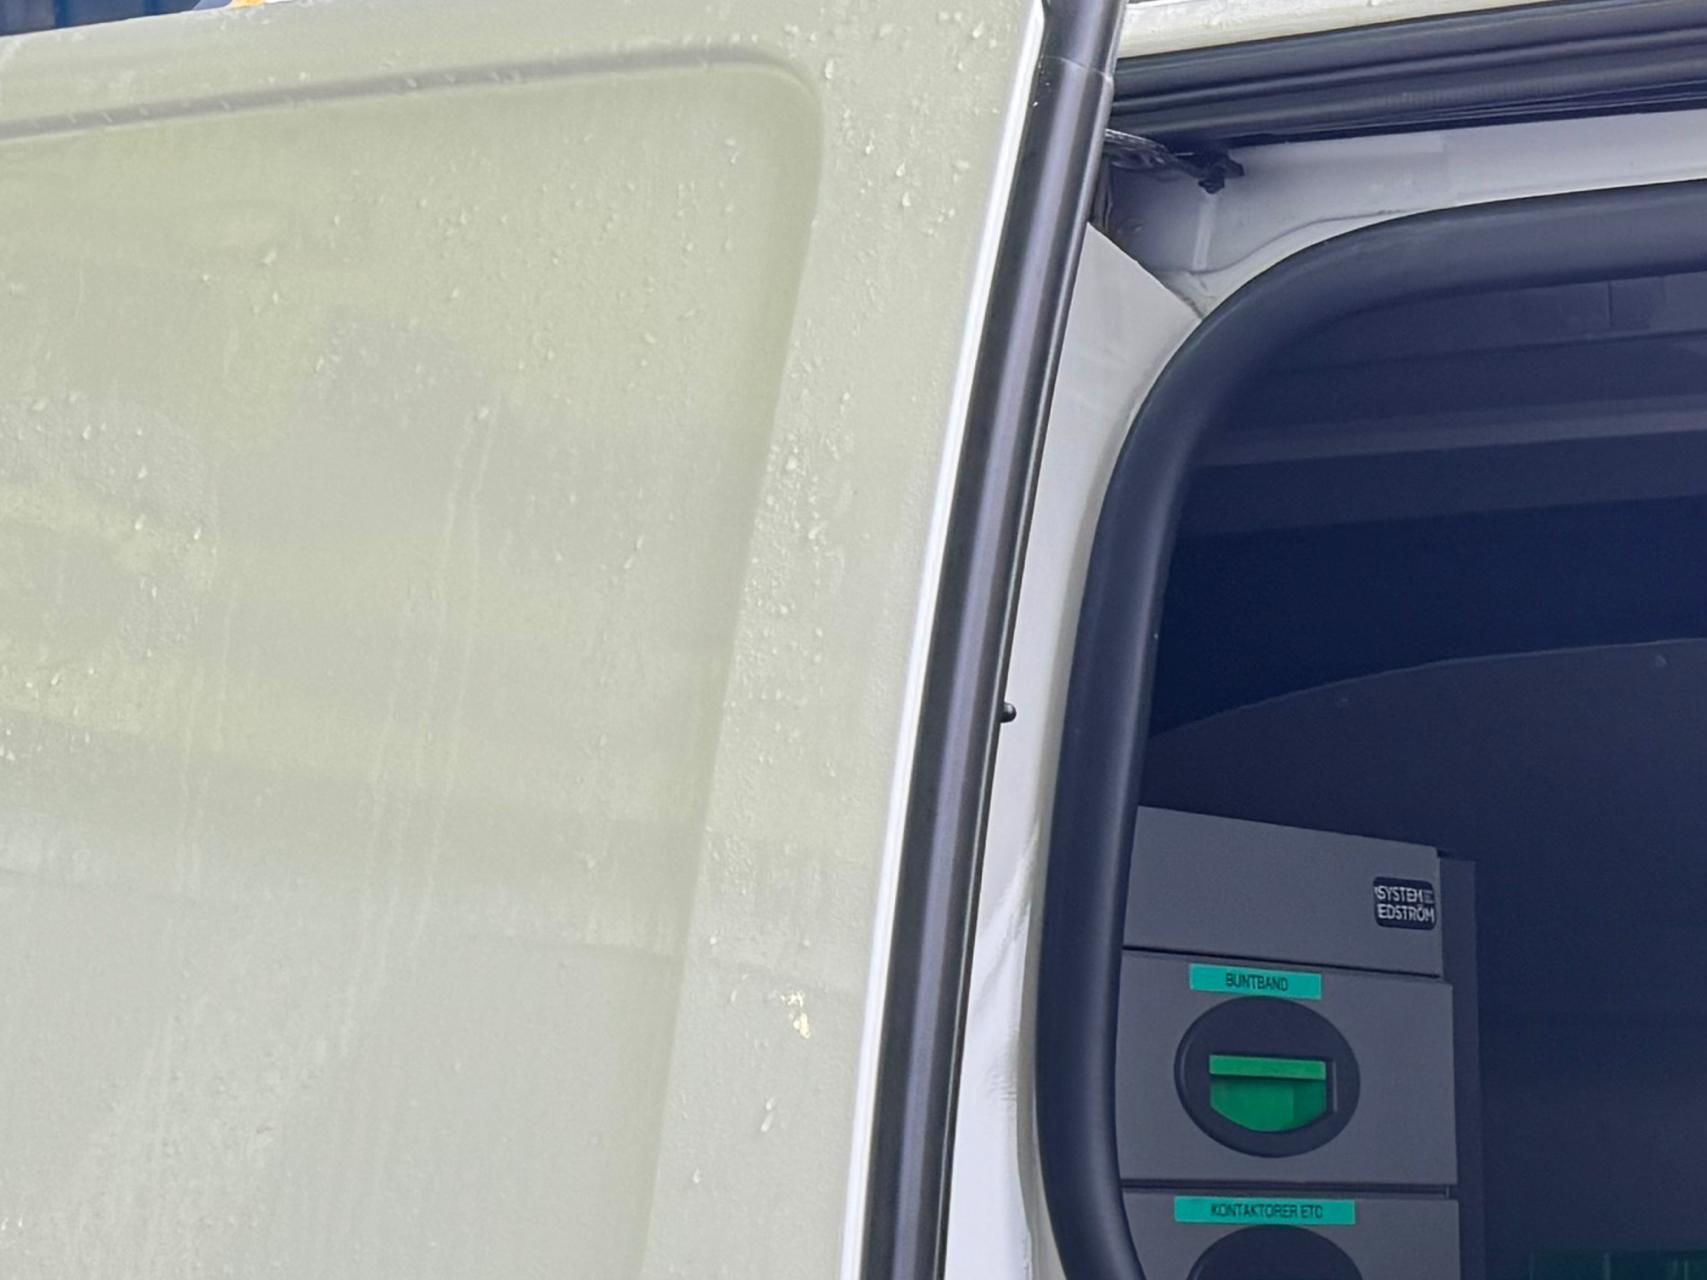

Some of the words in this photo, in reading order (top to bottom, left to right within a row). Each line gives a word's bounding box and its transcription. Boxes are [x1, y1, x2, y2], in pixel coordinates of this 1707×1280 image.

[1377, 903, 1435, 922] EDSTRÖM
[1225, 972, 1289, 992] BUNTBAND
[1211, 1203, 1297, 1218] KONTAKTORER
[1301, 1204, 1323, 1219] ETC
